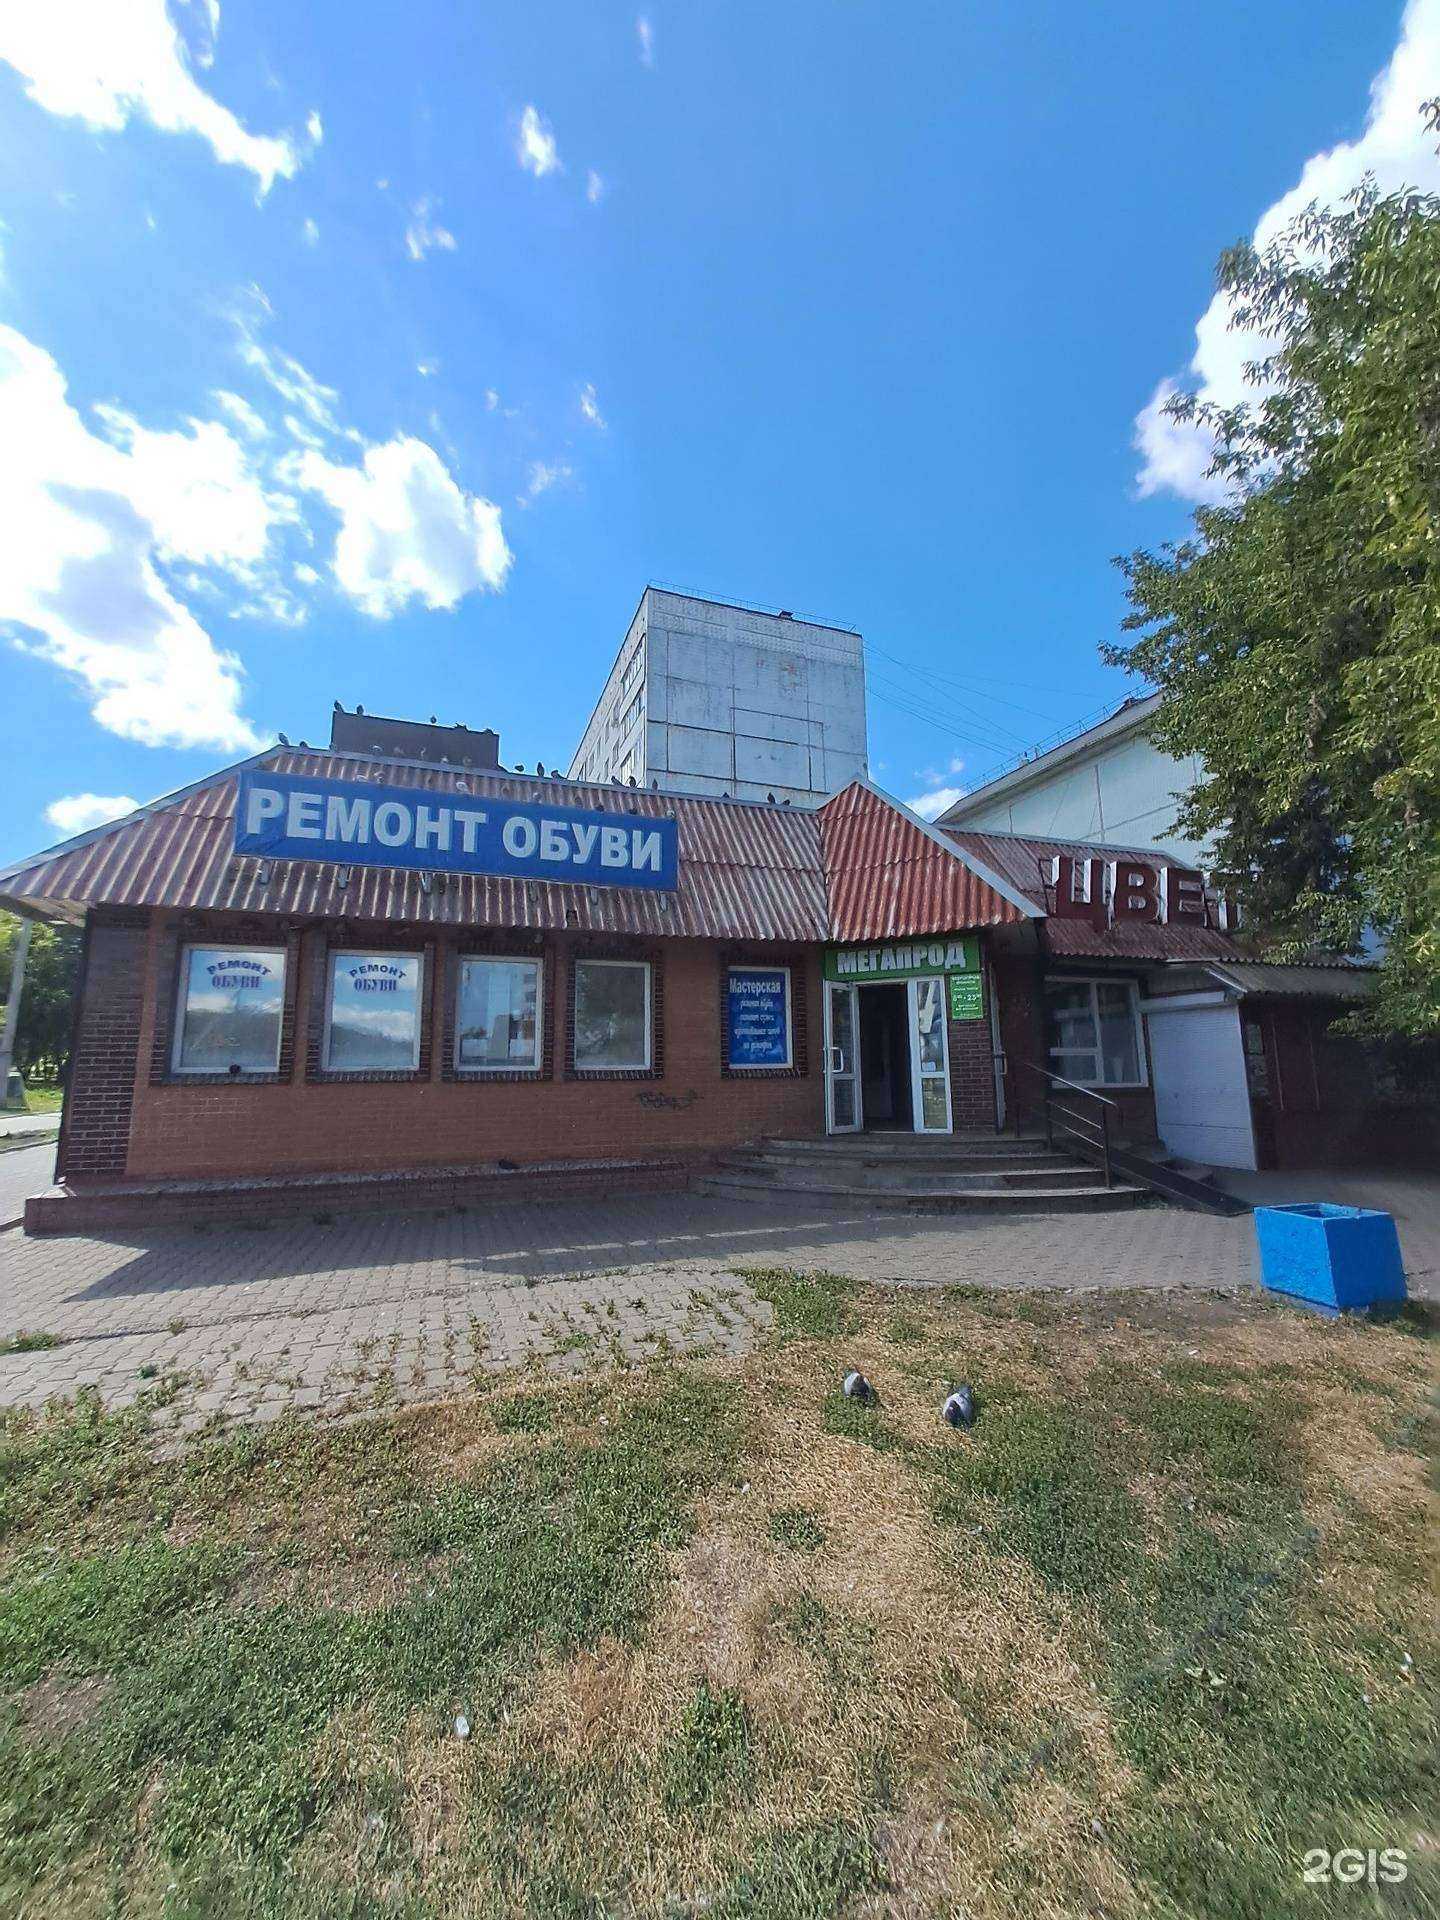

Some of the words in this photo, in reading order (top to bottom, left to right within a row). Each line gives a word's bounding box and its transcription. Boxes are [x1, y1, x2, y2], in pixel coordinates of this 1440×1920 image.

[246, 788, 487, 853] РЕМОНТ
[502, 816, 664, 872] ОБУВИ
[837, 942, 966, 974] МЕГАПРОД
[206, 960, 271, 975] РЕМОНТ
[349, 964, 407, 979] РЕМОНТ
[212, 975, 261, 989] ОБУВИ
[354, 978, 398, 991] ОБУВИ
[729, 978, 781, 996] Мастерская
